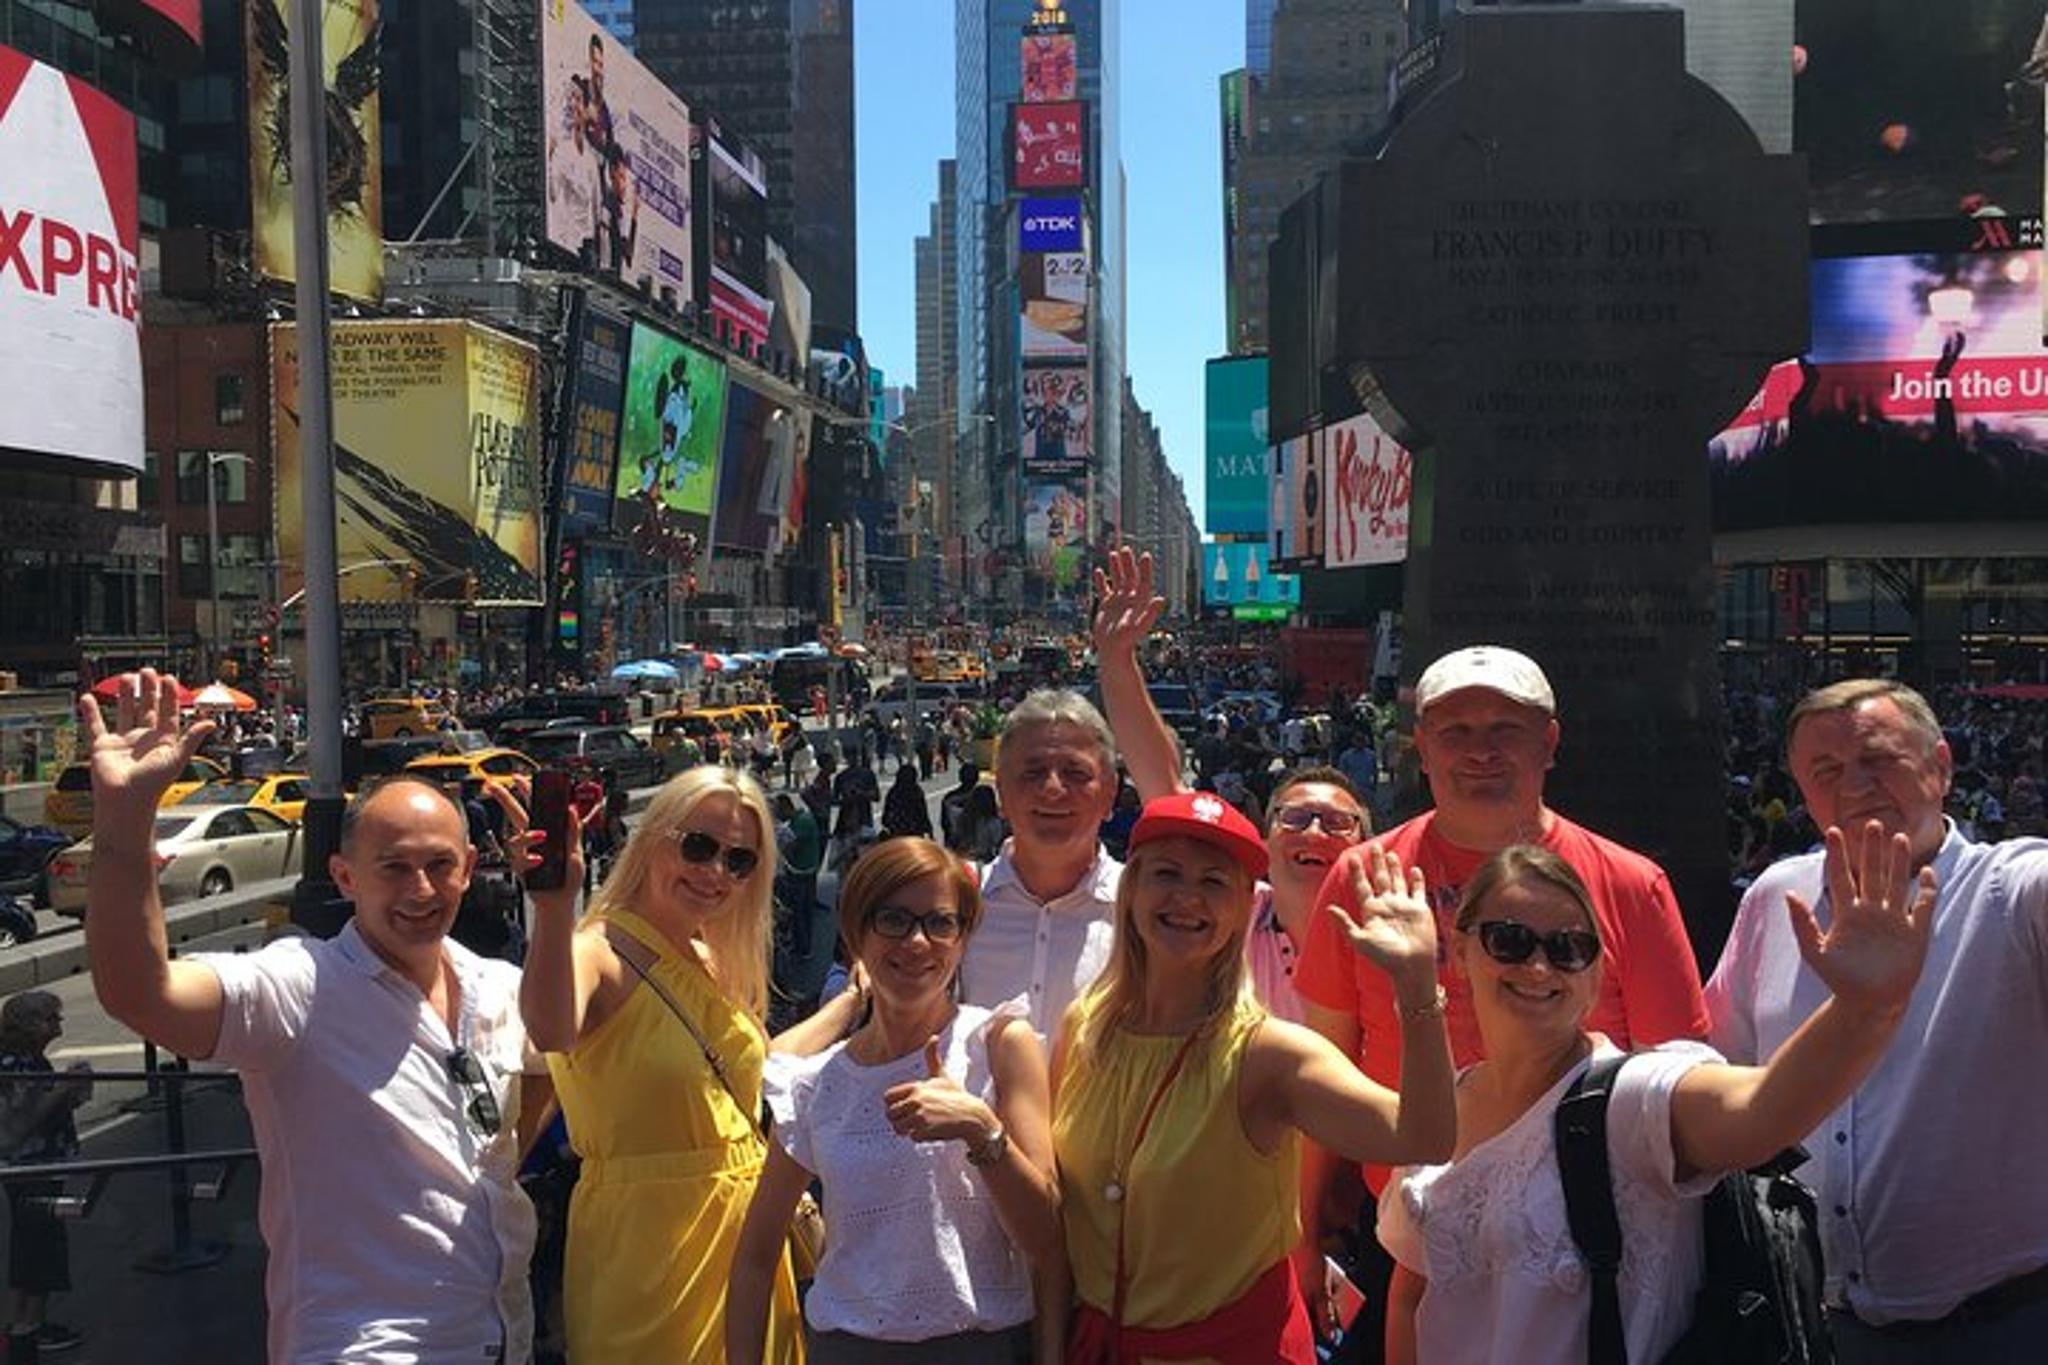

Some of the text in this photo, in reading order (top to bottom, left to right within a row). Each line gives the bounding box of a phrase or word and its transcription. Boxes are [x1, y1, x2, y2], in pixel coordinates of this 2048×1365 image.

[1036, 216, 1076, 231] TDK
[1432, 230, 1567, 261] FRANCIS
[1607, 226, 1718, 260] DUFFY
[399, 332, 438, 344] WILL
[367, 349, 398, 361] THE
[1889, 371, 1953, 401] Join
[1960, 369, 2013, 399] the
